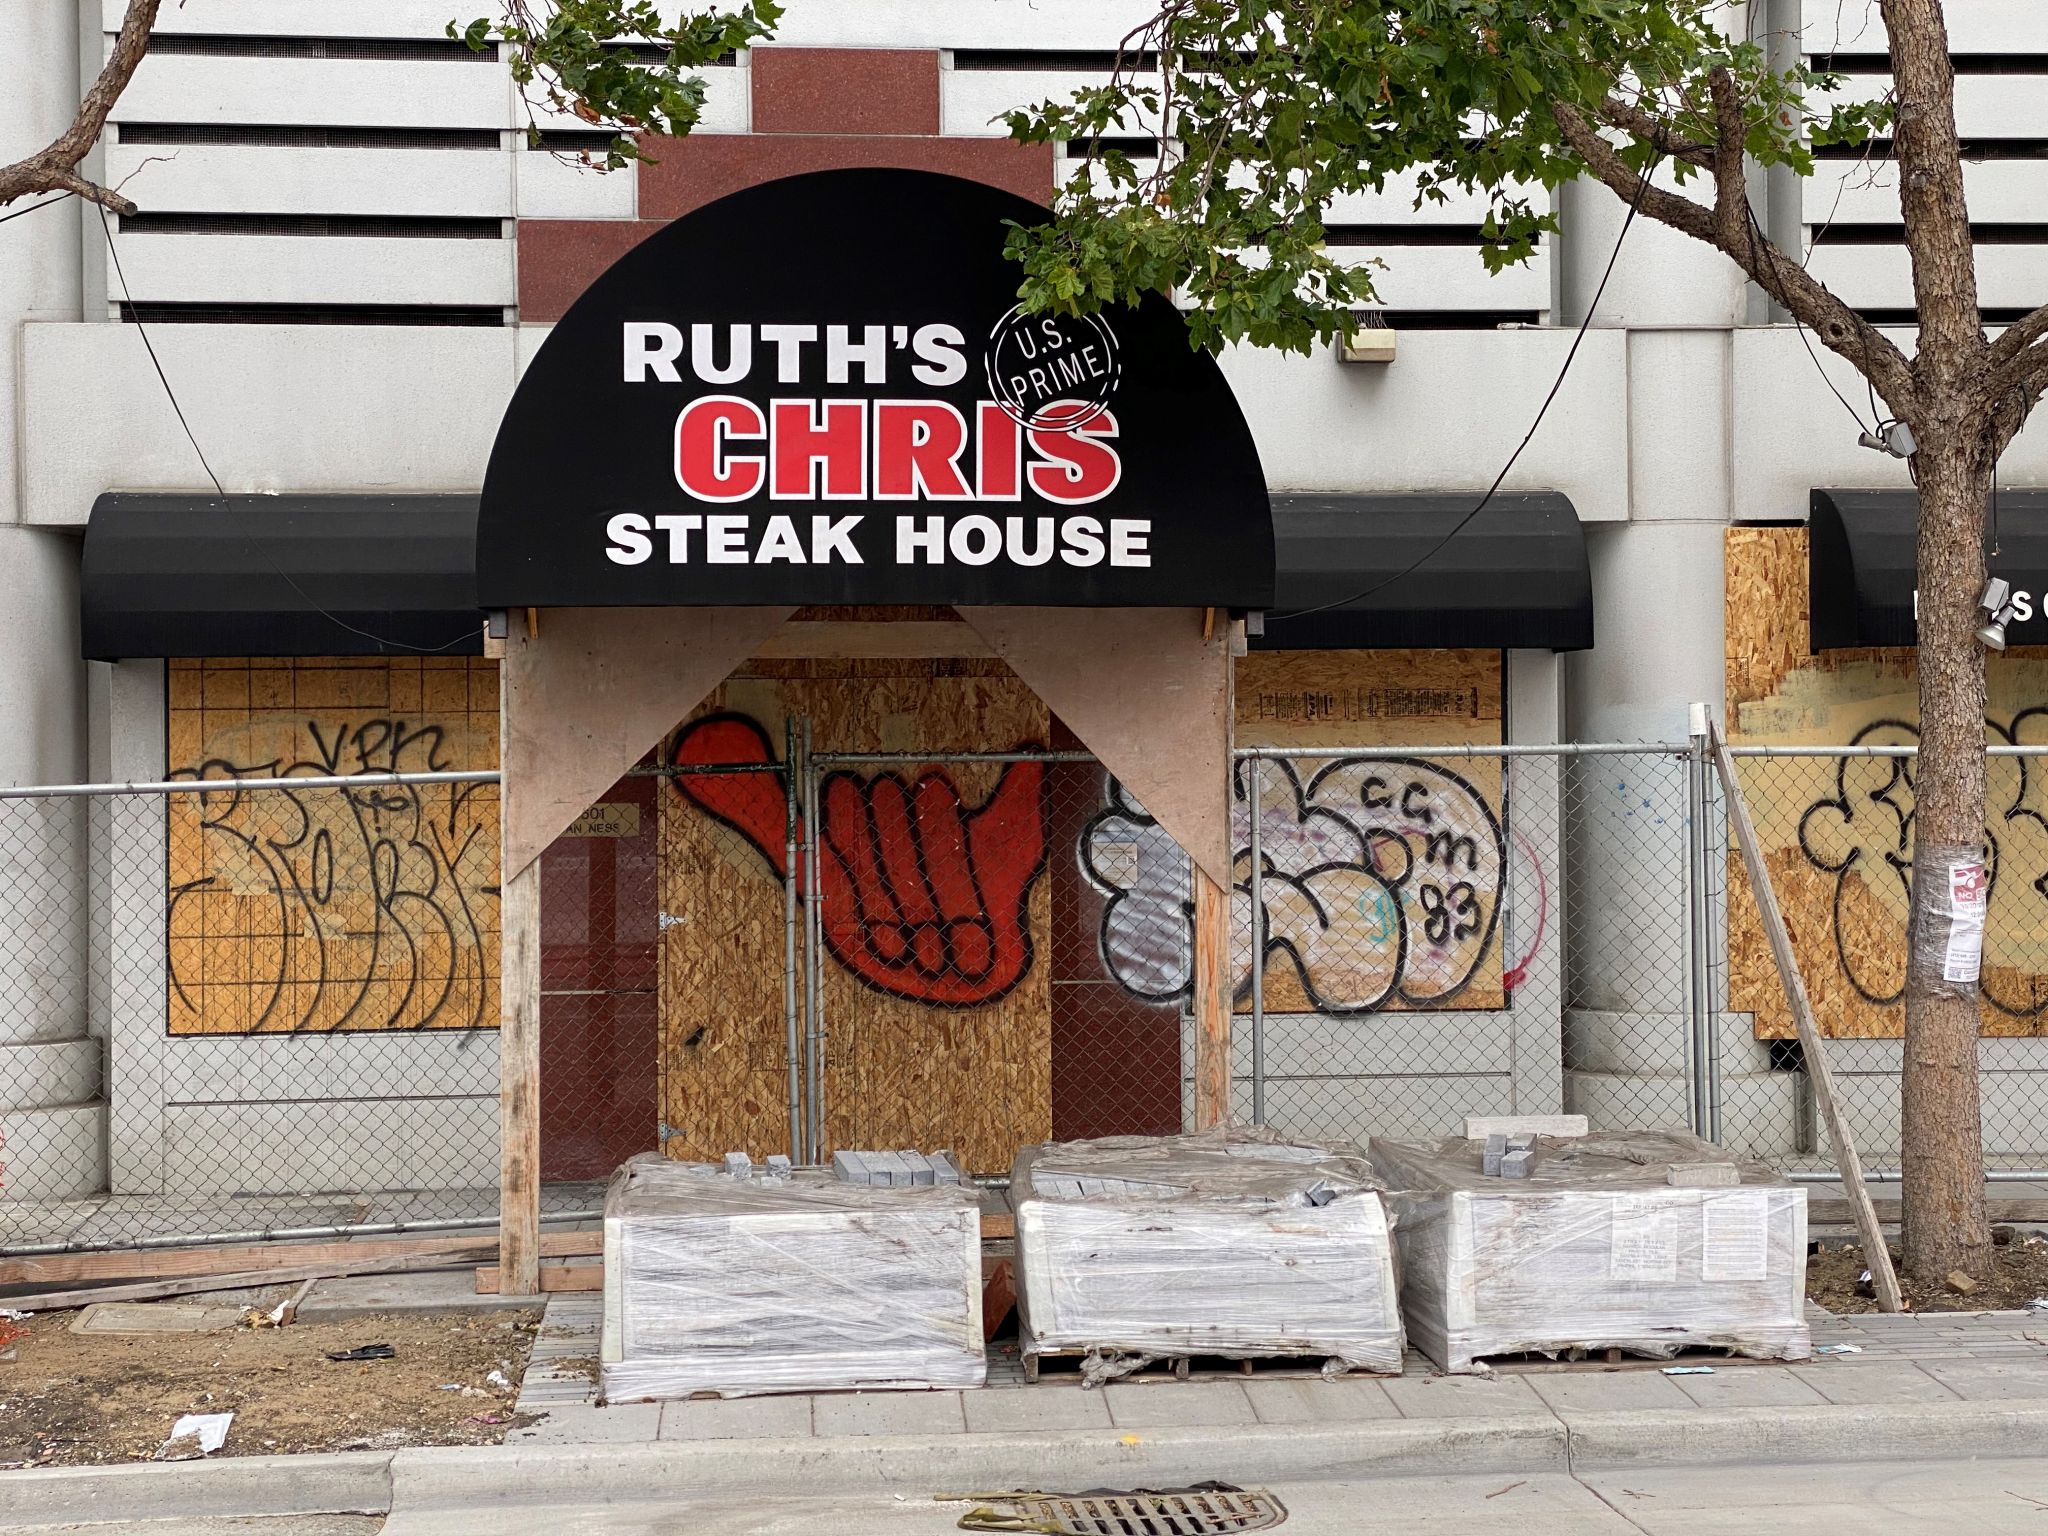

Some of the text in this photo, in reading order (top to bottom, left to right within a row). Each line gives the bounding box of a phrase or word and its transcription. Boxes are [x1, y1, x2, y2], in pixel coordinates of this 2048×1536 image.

[623, 321, 967, 385] RUTH'S
[1016, 316, 1073, 361] U.S.
[1010, 343, 1107, 408] PRIME
[673, 394, 1122, 505] CHRIS
[605, 512, 1152, 567] STEAK HOUSE
[565, 822, 620, 834] AN NESS
[581, 806, 606, 820] 601
